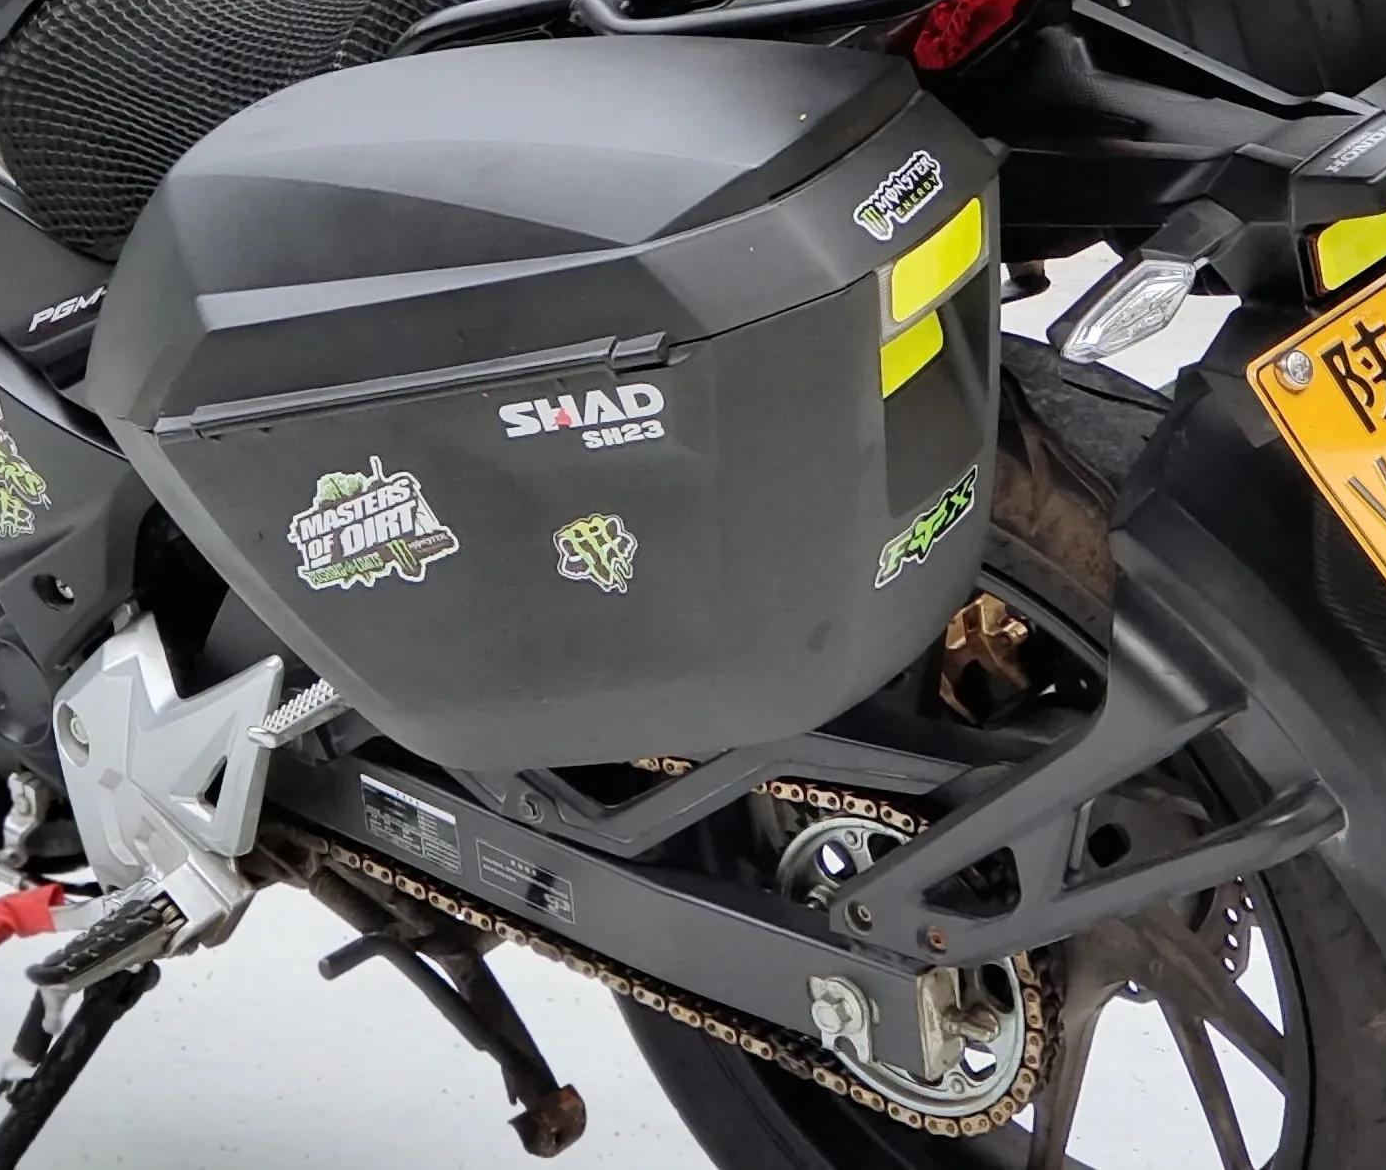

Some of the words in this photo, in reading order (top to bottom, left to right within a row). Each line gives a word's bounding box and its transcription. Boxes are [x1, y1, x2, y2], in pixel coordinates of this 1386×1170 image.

[874, 156, 936, 214] MONSTER
[498, 383, 665, 439] SHAD
[581, 419, 665, 449] SH23
[299, 479, 411, 541] MASTERS
[307, 533, 335, 560] OF
[340, 497, 418, 558] DIRT
